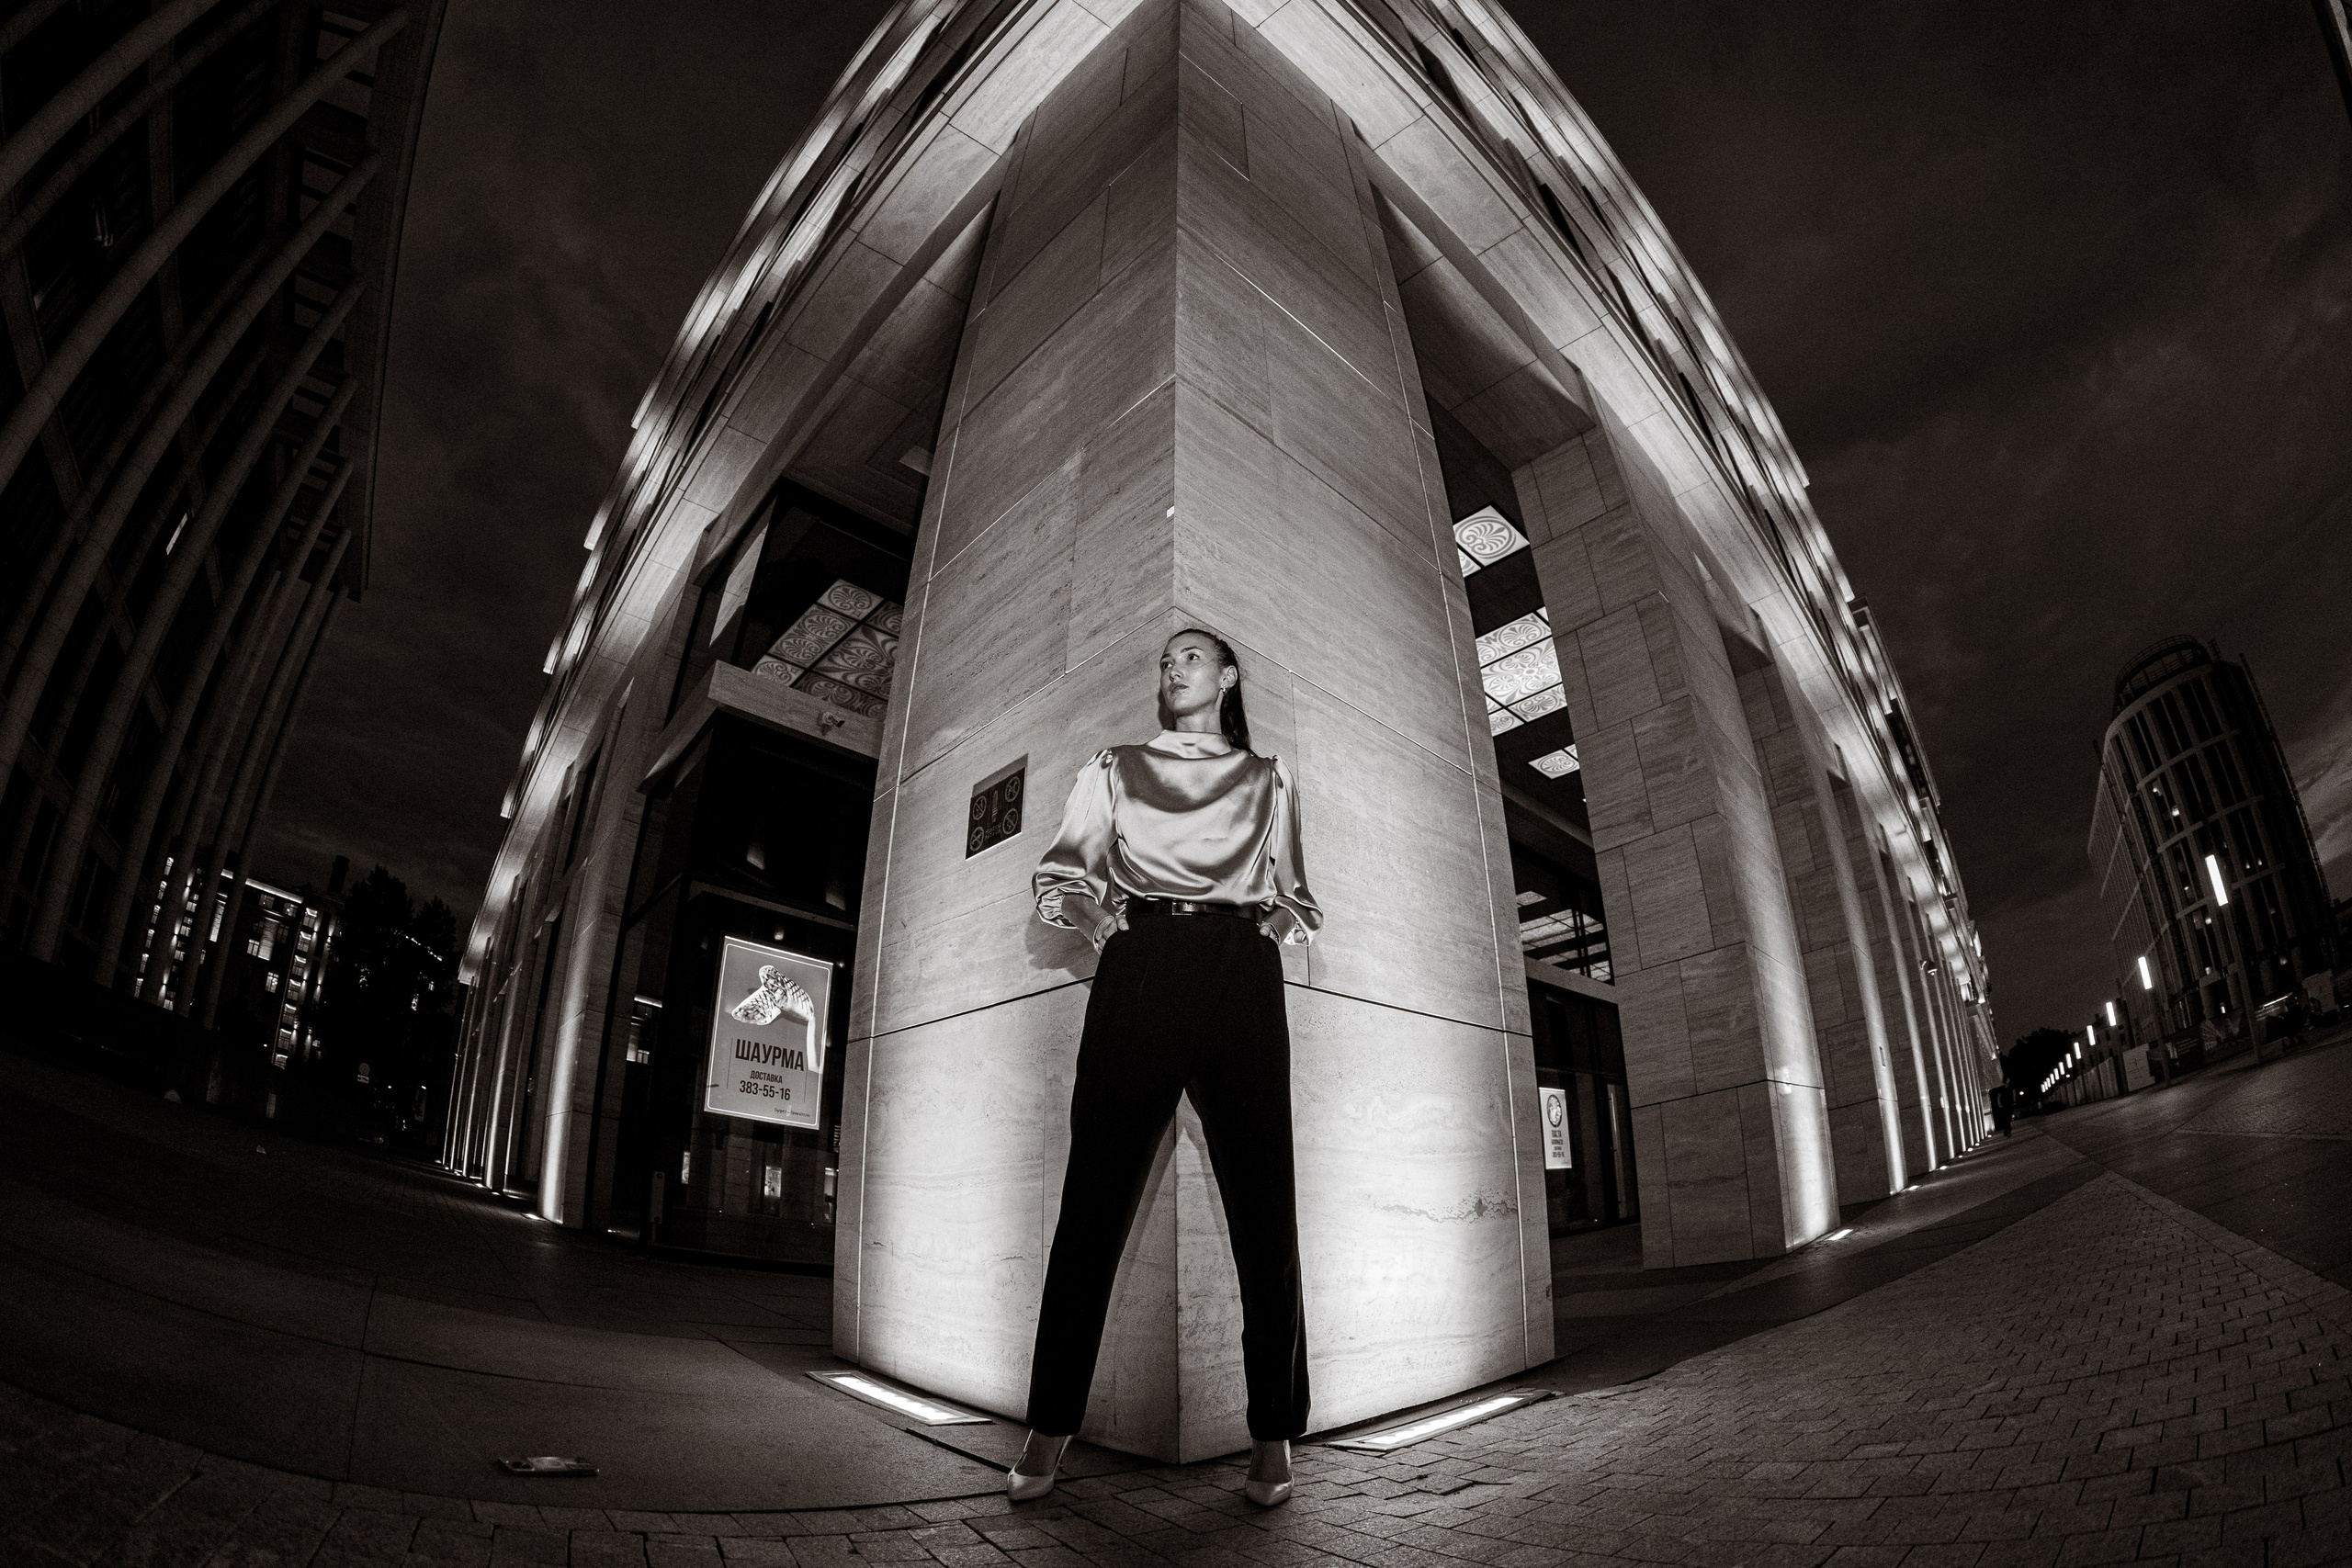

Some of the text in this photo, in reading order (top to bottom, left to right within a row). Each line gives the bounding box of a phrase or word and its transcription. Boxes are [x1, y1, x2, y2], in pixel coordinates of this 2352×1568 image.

[735, 1038, 805, 1072] ШАУРМА
[750, 1070, 783, 1084] ДОСТАВКА
[739, 1079, 791, 1101] 383-55-16
